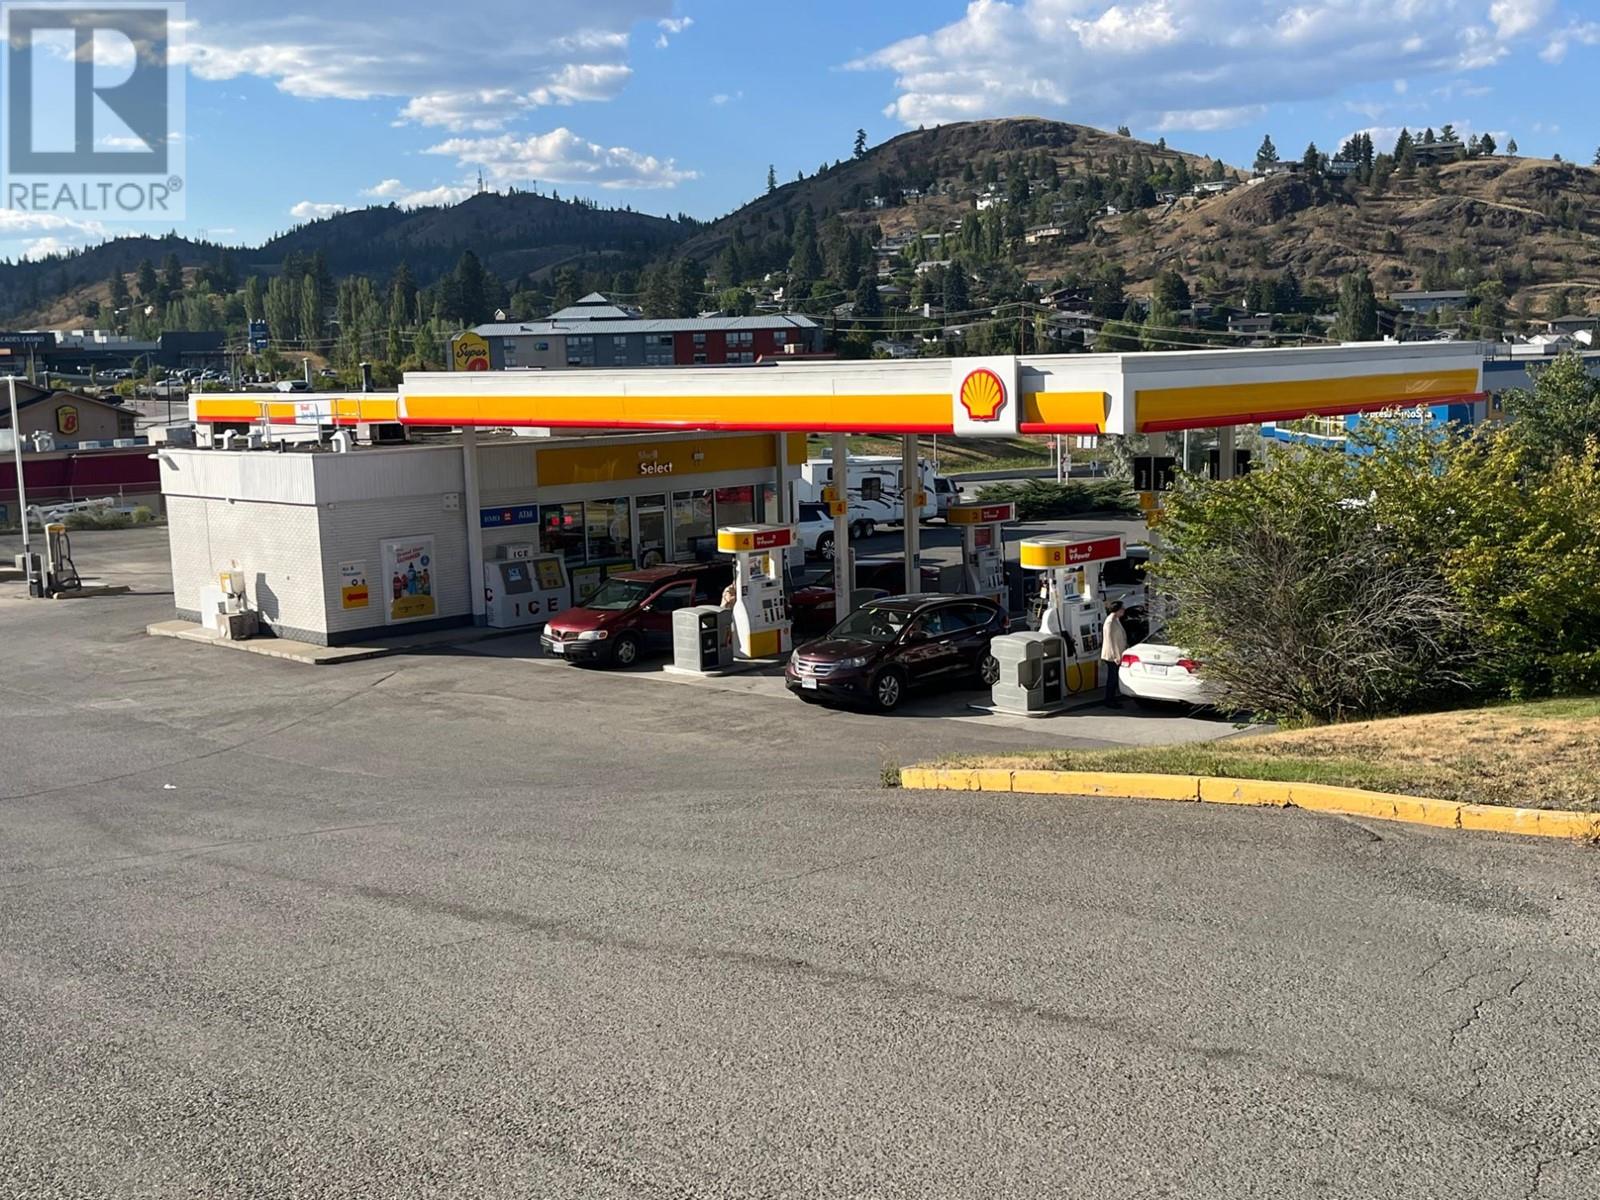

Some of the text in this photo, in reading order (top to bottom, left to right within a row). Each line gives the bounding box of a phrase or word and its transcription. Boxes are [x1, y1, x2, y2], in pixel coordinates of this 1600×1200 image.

[456, 343, 487, 364] Super
[640, 461, 673, 475] Select
[836, 503, 843, 513] 4
[518, 510, 533, 520] ATM
[742, 537, 750, 545] 4
[513, 549, 528, 558] ICE
[1053, 550, 1061, 561] 8
[1069, 552, 1091, 561] V-Power
[514, 597, 559, 617] ICE
